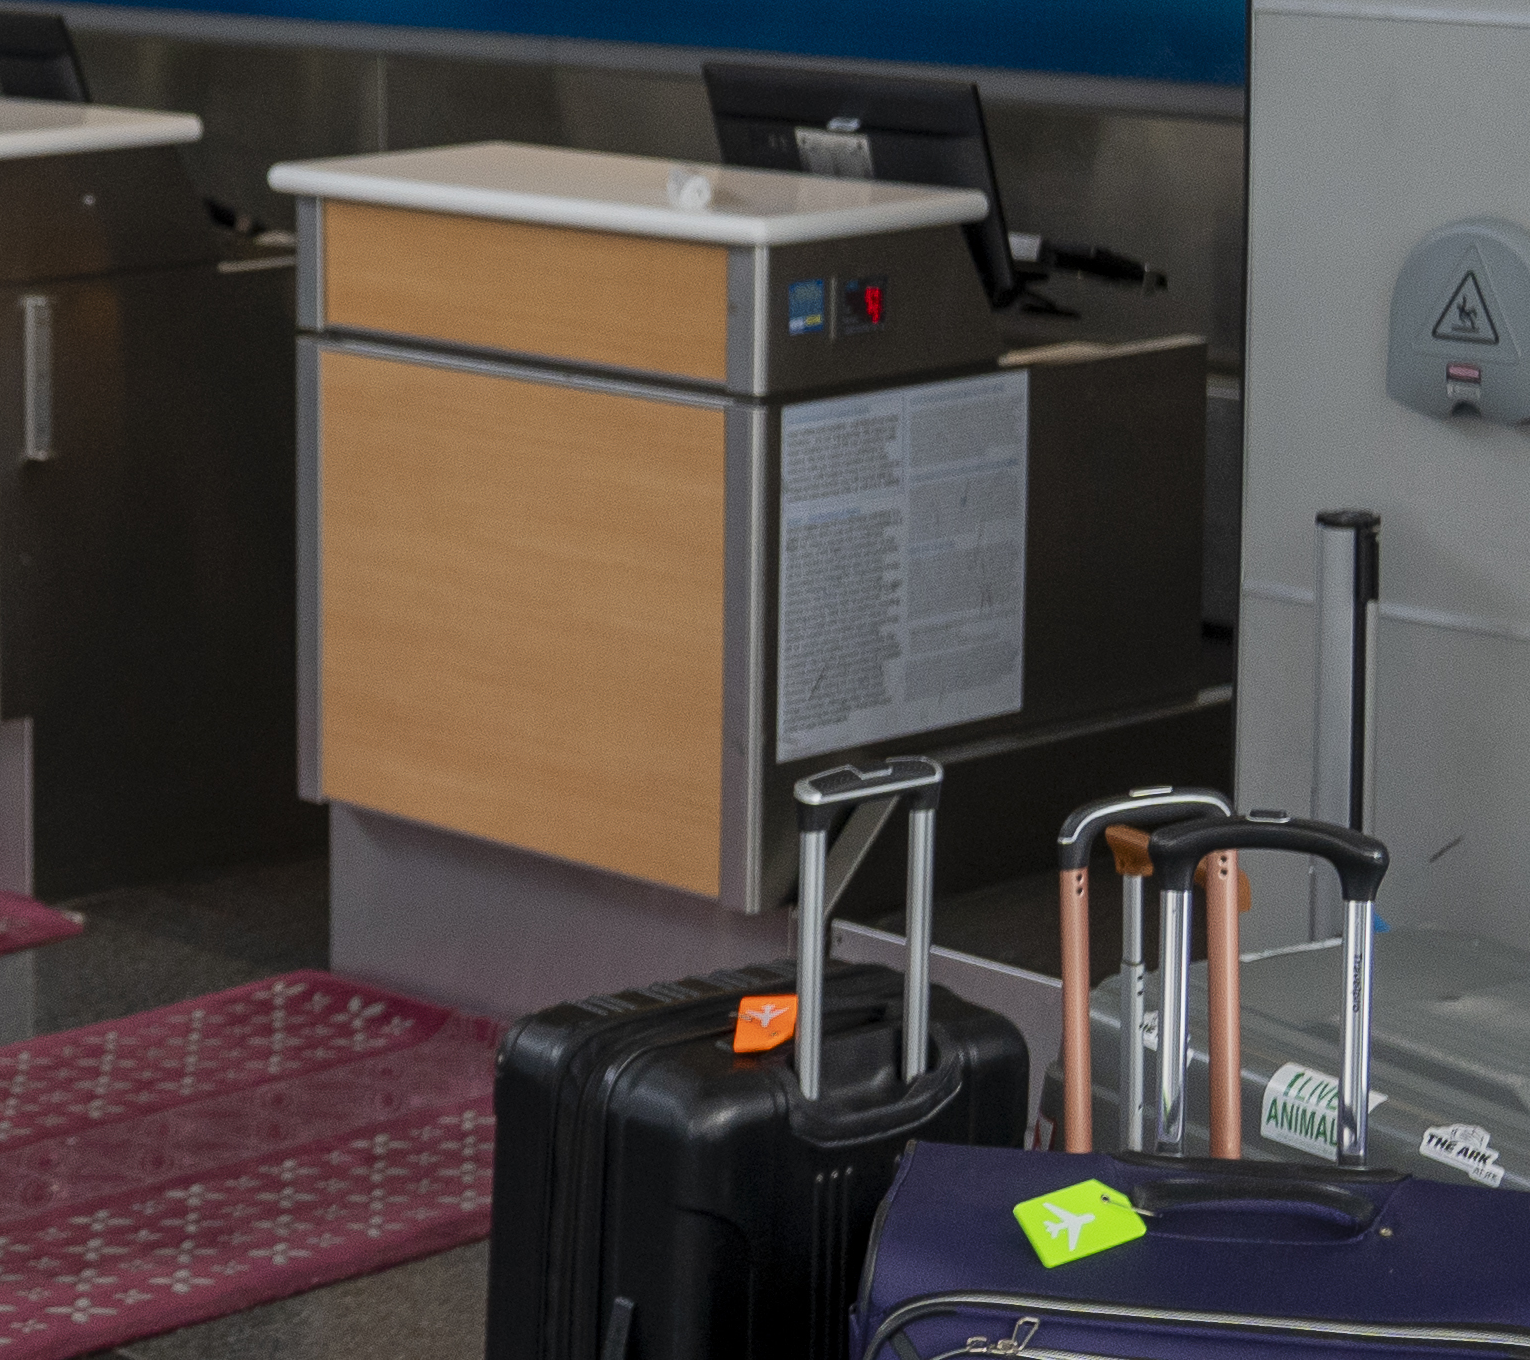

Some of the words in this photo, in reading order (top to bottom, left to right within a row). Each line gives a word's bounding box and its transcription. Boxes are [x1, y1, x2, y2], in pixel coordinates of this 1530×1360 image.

[1266, 1097, 1339, 1147] ANIMAL
[1428, 1133, 1457, 1153] THE
[1457, 1146, 1491, 1165] ARK
